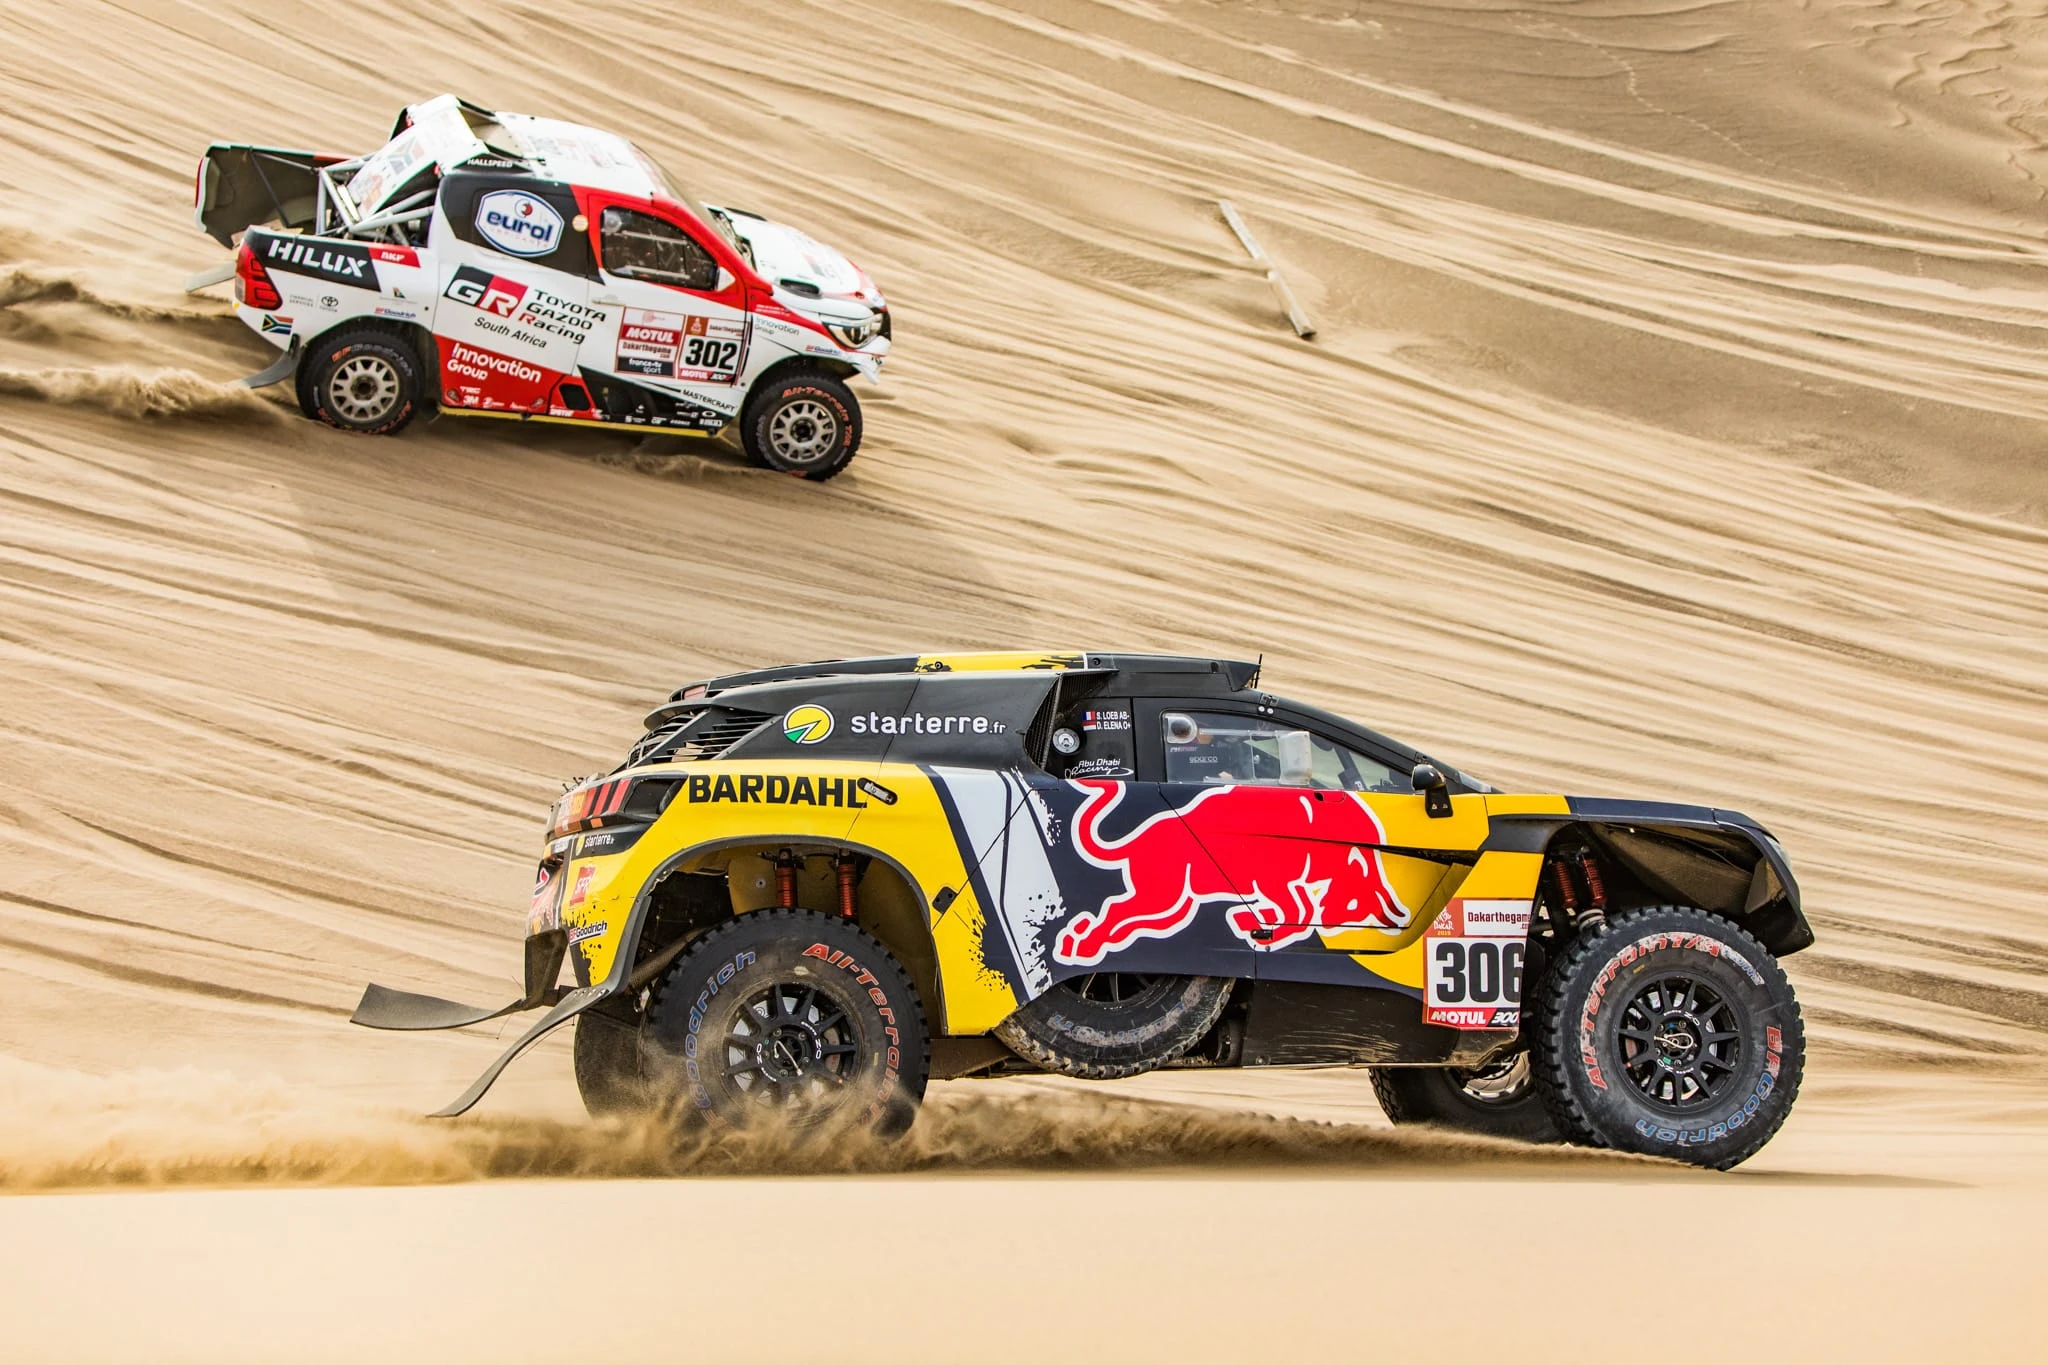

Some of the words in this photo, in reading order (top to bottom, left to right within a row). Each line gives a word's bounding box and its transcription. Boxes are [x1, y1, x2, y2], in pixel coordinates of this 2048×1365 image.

[467, 158, 514, 168] HALLSPEED
[486, 210, 554, 241] eurol
[268, 239, 368, 278] HILUX
[447, 278, 519, 318] GR
[533, 289, 607, 323] TOYOTA
[518, 312, 586, 345] Racing
[526, 302, 593, 331] GAZOO
[756, 317, 800, 336] Innovation
[474, 316, 510, 336] South
[511, 329, 547, 349] Africa
[626, 327, 675, 344] MOTUL
[622, 341, 672, 355] Dakarthegame
[685, 338, 738, 371] 302
[447, 359, 489, 381] Group
[452, 342, 542, 384] Innovation
[681, 369, 708, 379] MOTUL
[682, 389, 738, 412] MASTERCRAFT
[1096, 711, 1102, 720] S.
[1102, 711, 1119, 720] LOEB
[1096, 721, 1102, 730] D.
[1103, 721, 1123, 730] ELENA
[1071, 764, 1119, 776] Racing
[1078, 760, 1095, 769] Abu
[1095, 758, 1121, 767] Dhabi
[688, 774, 868, 808] BARDAHL
[569, 919, 608, 941] BFGoodrich
[1435, 942, 1525, 1003] 306
[803, 942, 900, 1100] All-Terrain
[1430, 1010, 1487, 1025] MOTUL
[1635, 1026, 1783, 1144] BFGoodrich
